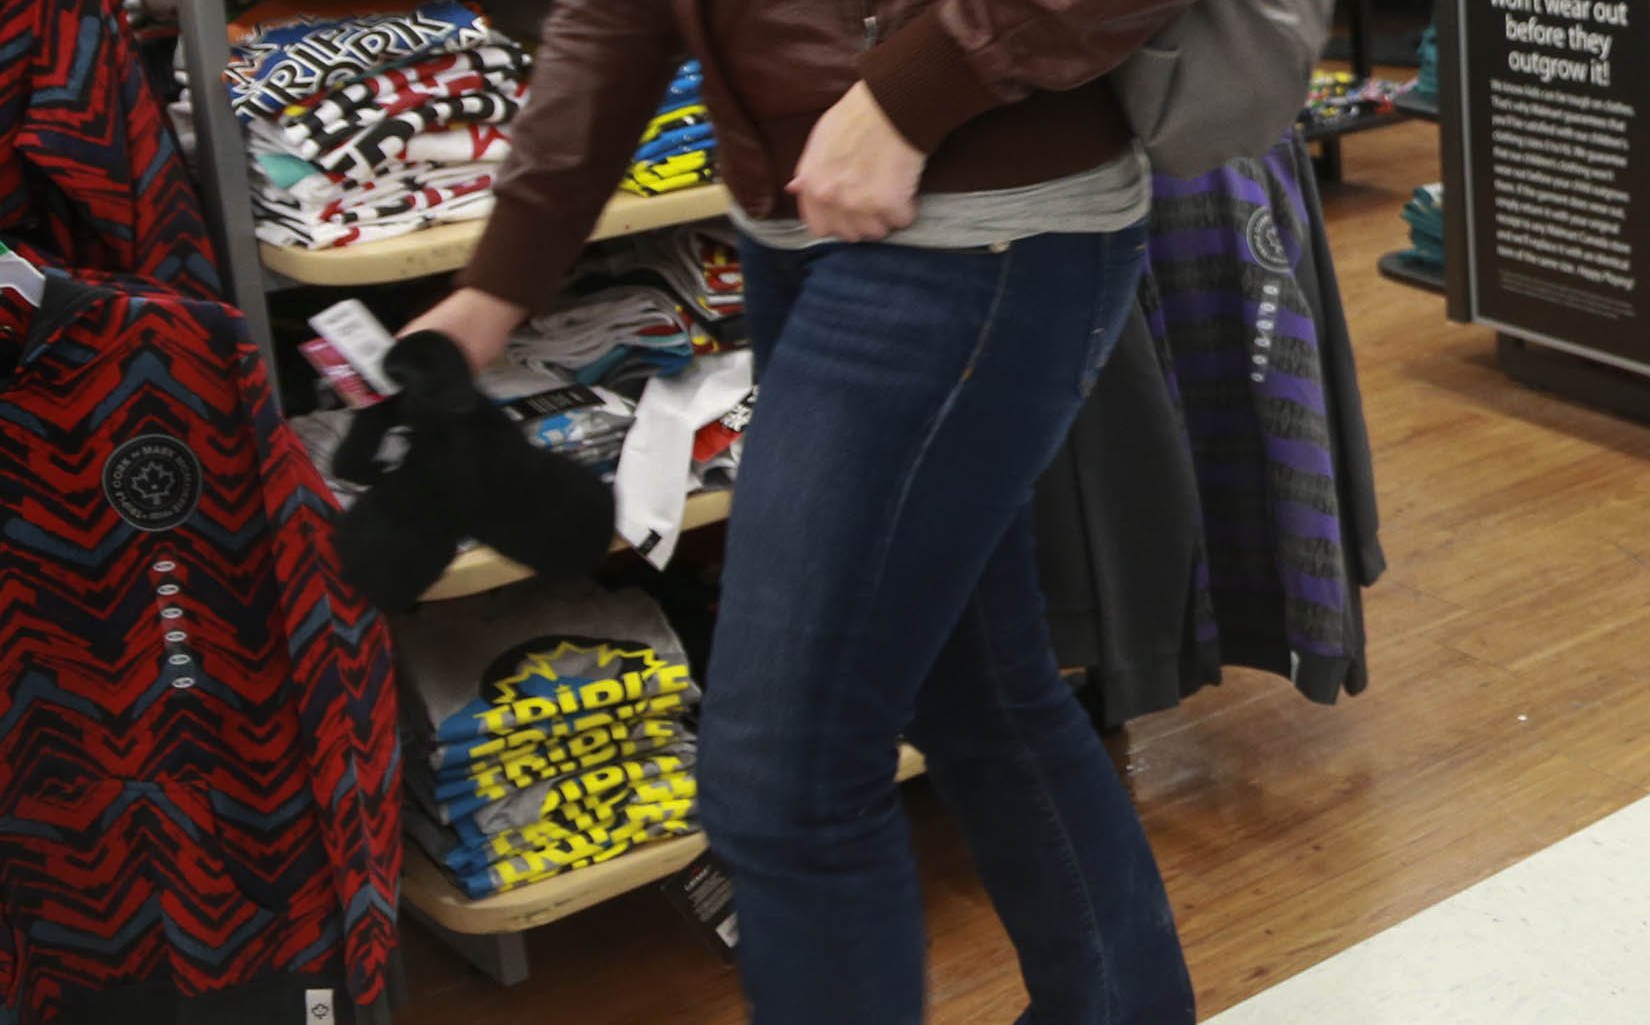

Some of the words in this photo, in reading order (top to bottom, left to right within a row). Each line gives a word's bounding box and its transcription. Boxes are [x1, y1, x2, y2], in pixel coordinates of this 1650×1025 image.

[1593, 0, 1629, 26] out
[1505, 12, 1567, 49] before
[1568, 24, 1614, 61] they
[1508, 50, 1588, 84] outgrow
